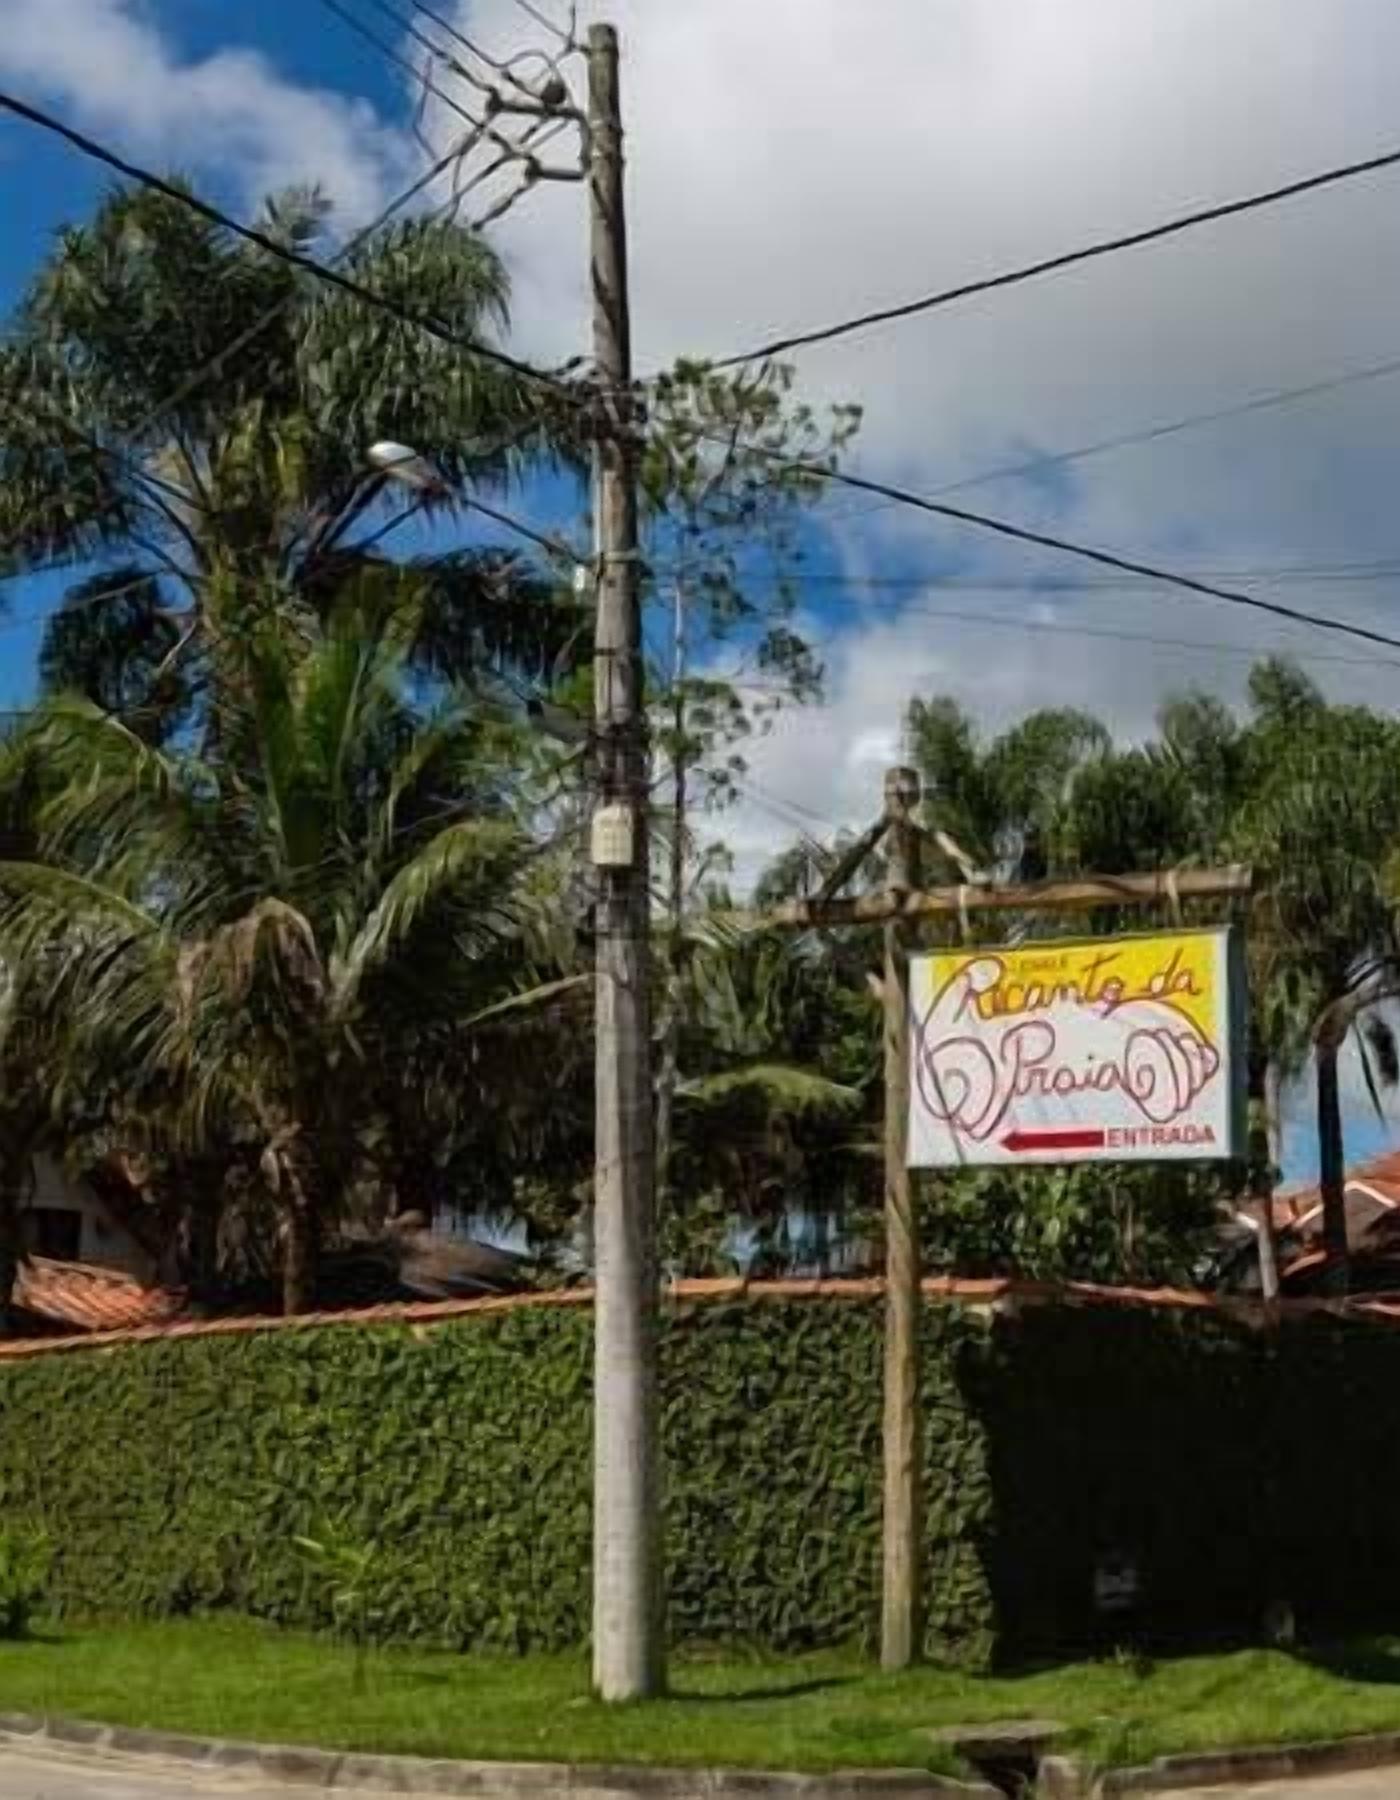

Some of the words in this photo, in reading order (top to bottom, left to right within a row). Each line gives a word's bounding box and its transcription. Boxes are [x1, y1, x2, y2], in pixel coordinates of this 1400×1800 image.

[1144, 948, 1202, 1000] da
[1001, 1020, 1122, 1098] Praia
[1107, 1124, 1216, 1148] ENTRADA
